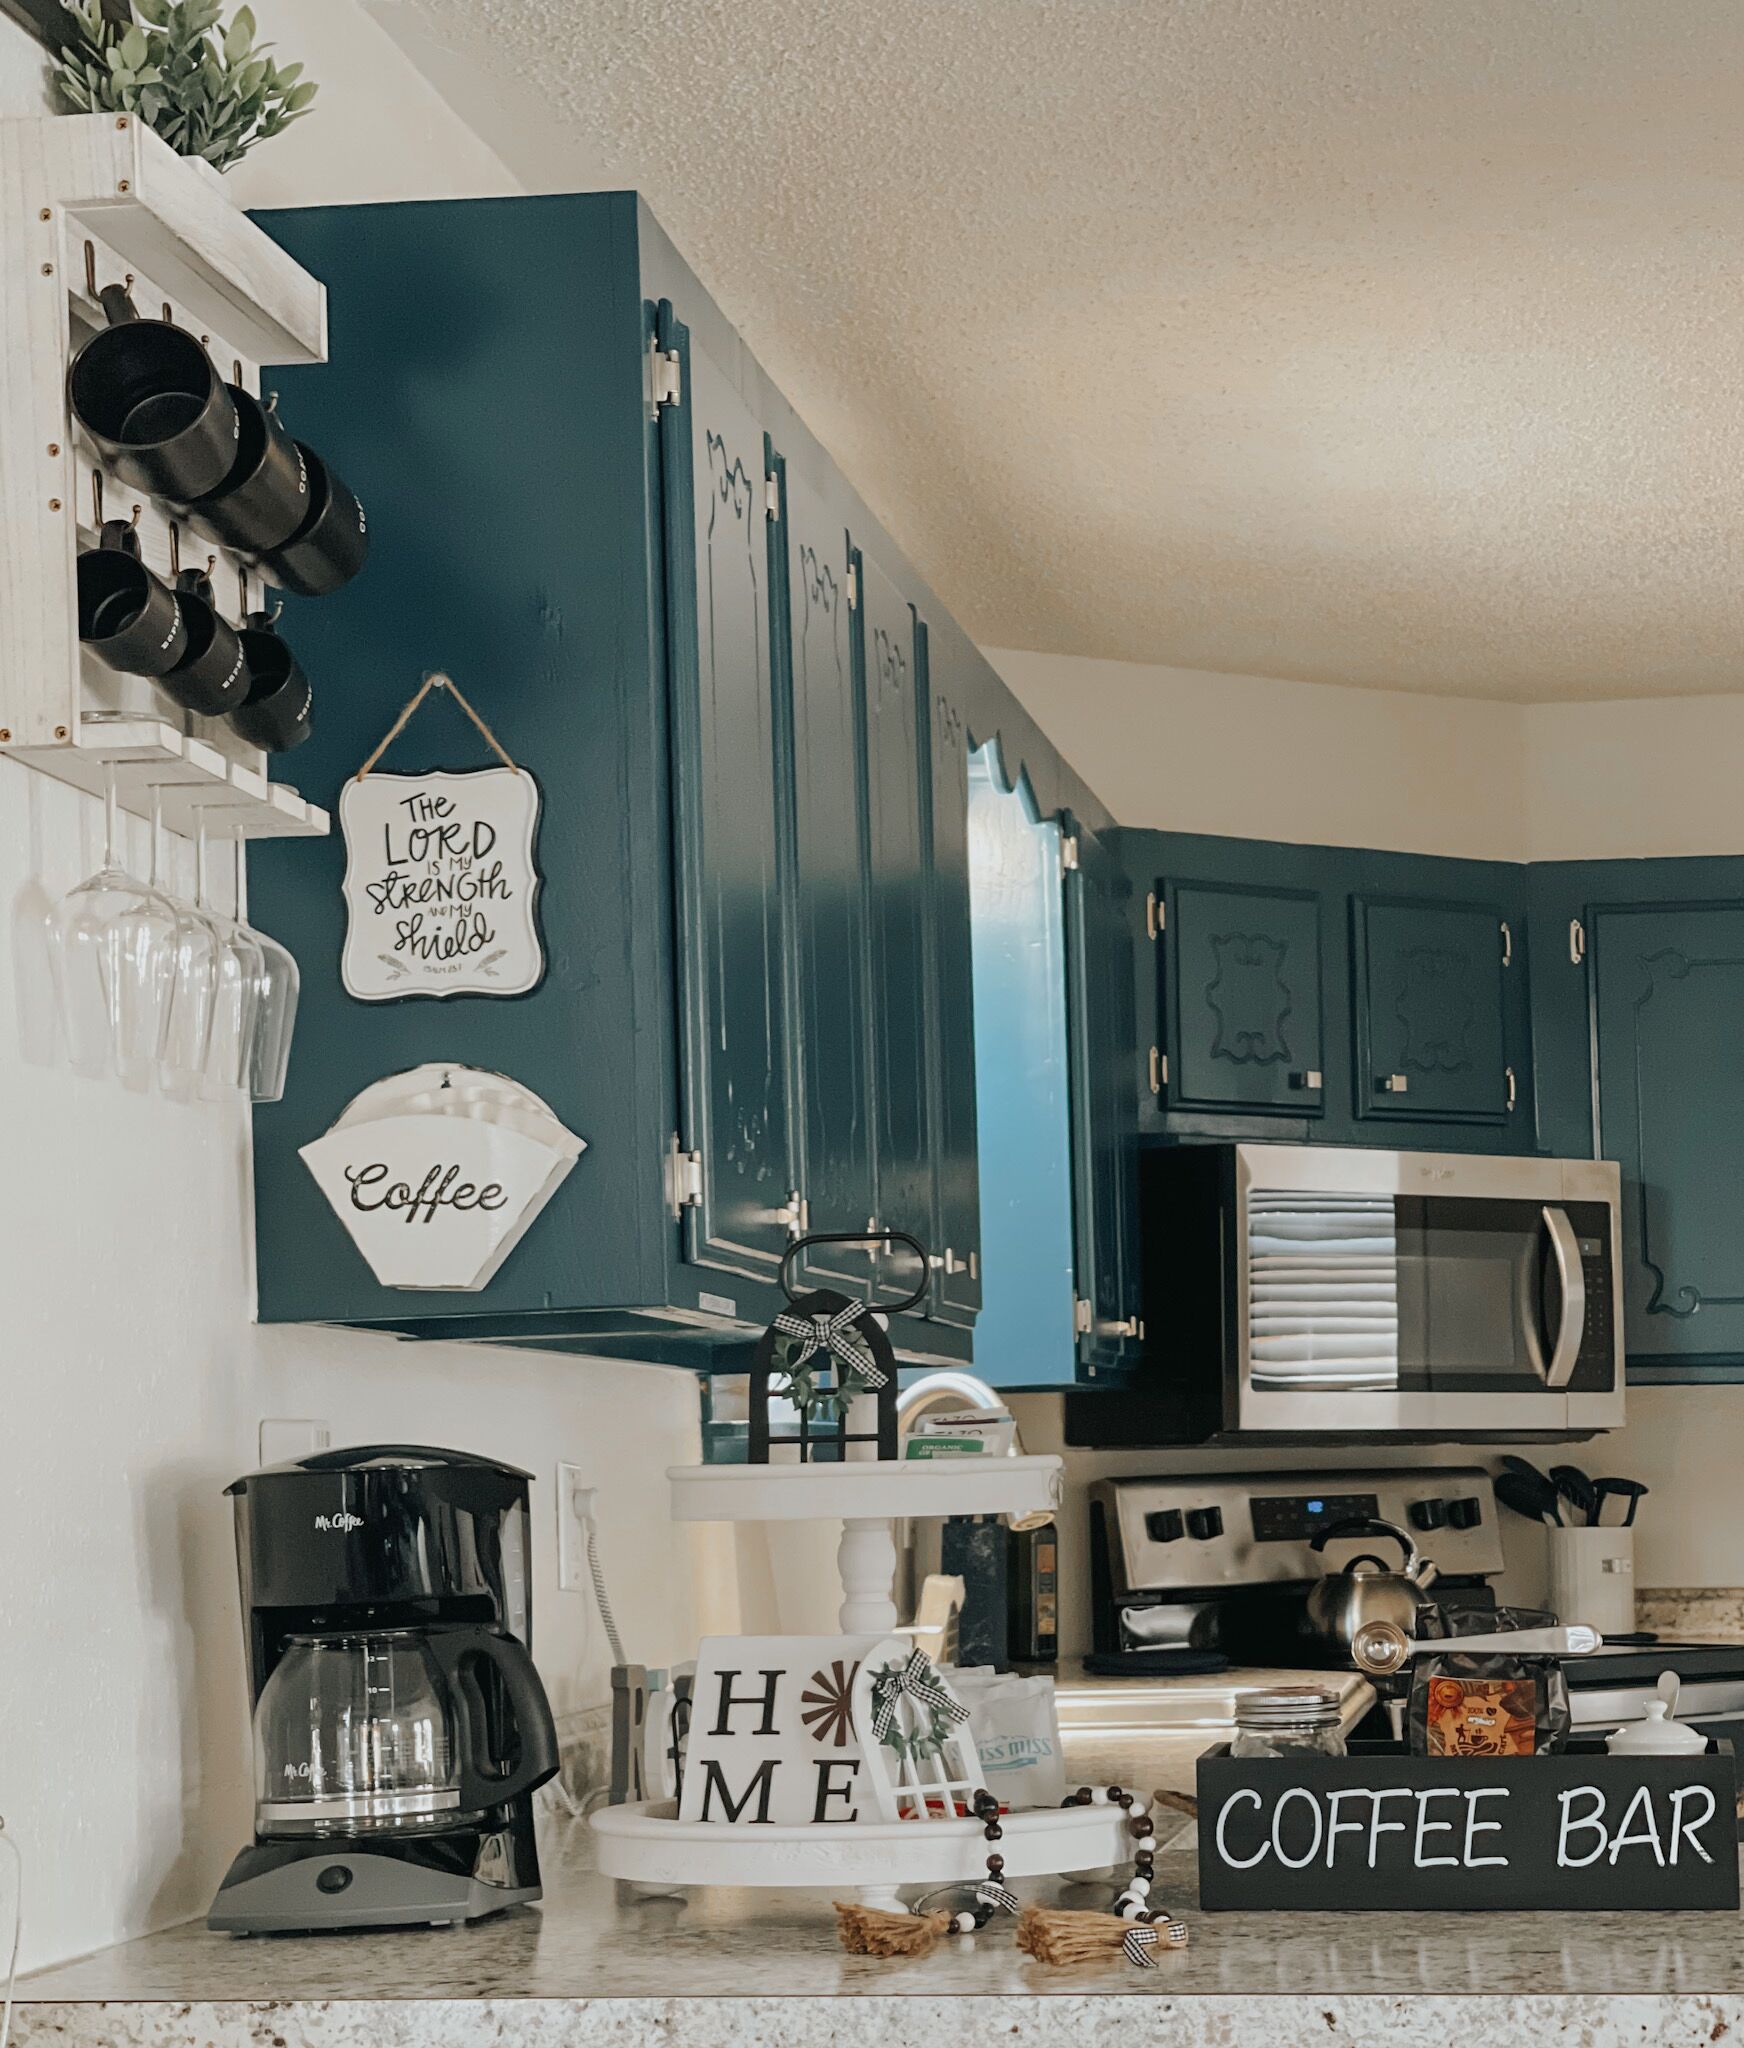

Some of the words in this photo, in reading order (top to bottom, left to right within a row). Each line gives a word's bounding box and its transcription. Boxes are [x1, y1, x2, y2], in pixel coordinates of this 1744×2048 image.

[385, 821, 496, 866] LORD
[427, 860, 440, 876] IS
[344, 1163, 508, 1223] Coffee
[332, 1512, 364, 1533] Coffee
[1215, 1787, 1509, 1869] COFFEE
[1556, 1785, 1716, 1867] BAR
